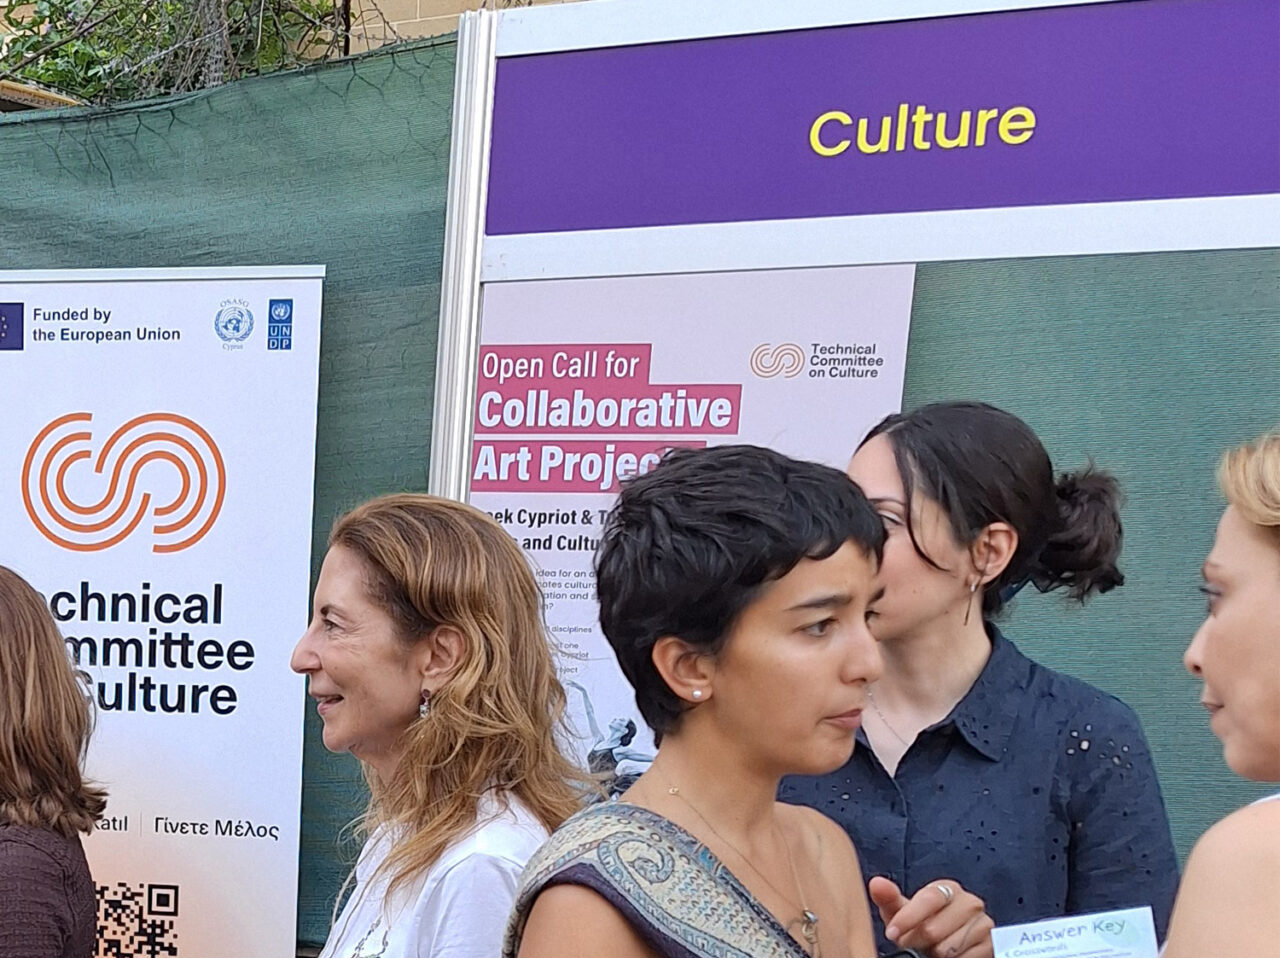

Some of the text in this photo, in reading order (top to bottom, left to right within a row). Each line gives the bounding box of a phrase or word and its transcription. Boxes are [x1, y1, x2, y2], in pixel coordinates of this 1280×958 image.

[809, 103, 1036, 157] Culture
[33, 307, 111, 324] Funded by
[32, 327, 181, 344] the European Union
[810, 355, 884, 366] Committee
[811, 343, 876, 355] Technical
[482, 350, 640, 385] Open Call for
[809, 367, 878, 378] on Culture
[478, 389, 732, 428] Collaborative
[473, 444, 665, 490] Art Projec
[517, 508, 577, 528] Cypriot
[581, 510, 593, 525] &
[522, 534, 600, 551] and Cultu
[48, 581, 222, 625] chnical
[65, 628, 255, 671] mmittee
[79, 670, 238, 715] ulture
[155, 817, 280, 841] Γίνετε Μέλος
[1018, 919, 1126, 945] Answer Key
